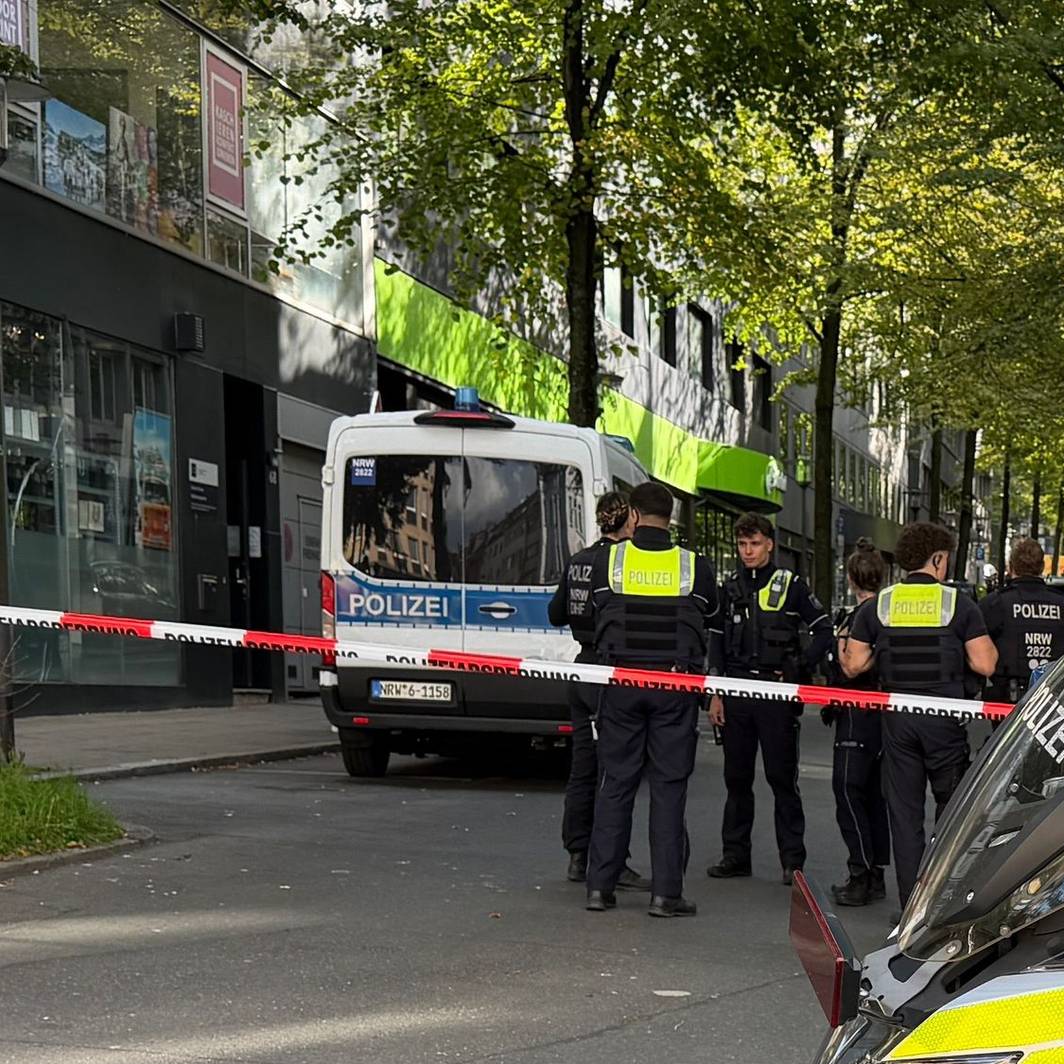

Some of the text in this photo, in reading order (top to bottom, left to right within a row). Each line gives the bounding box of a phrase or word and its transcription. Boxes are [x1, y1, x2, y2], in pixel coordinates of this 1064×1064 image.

[352, 458, 375, 467] NRW
[568, 564, 592, 582] POLIZ
[629, 570, 673, 586] POLIZEI
[570, 588, 589, 601] NRW
[349, 593, 448, 617] POLIZEI
[895, 601, 937, 615] POLIZEI
[1013, 604, 1060, 619] POLIZEI
[1025, 632, 1052, 645] NRW
[1026, 645, 1052, 658] 2822
[408, 684, 450, 698] 6-1158
